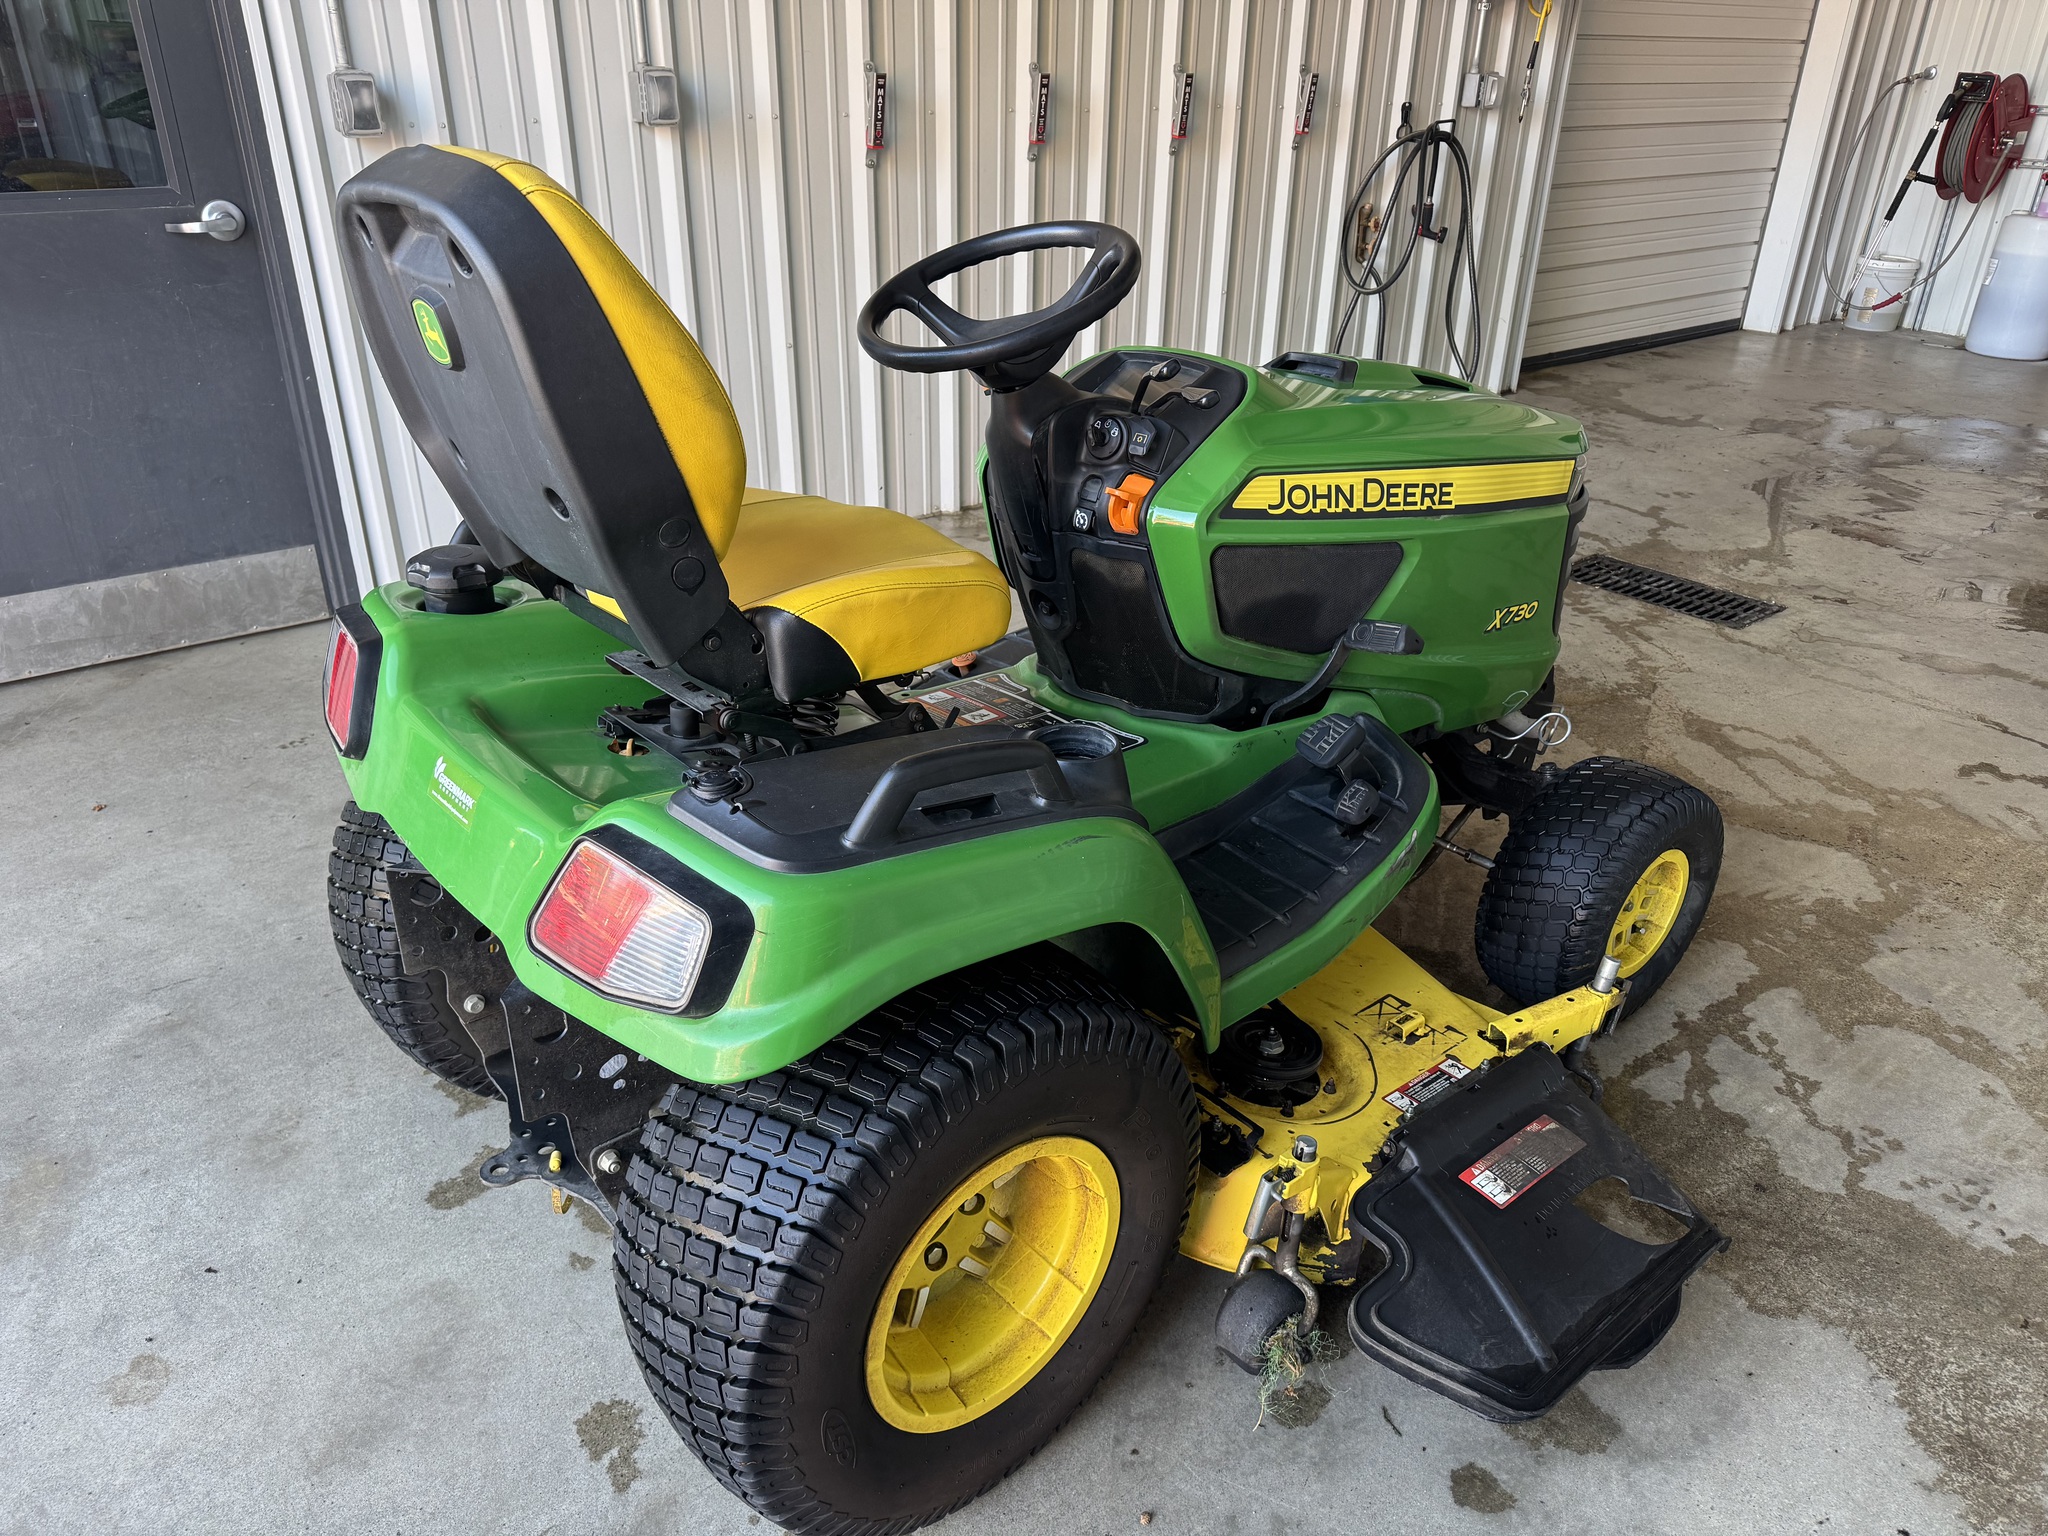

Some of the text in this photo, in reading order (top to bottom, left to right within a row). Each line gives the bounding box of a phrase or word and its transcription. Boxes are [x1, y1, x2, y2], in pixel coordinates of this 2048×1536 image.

[1040, 86, 1048, 116] MATS
[1183, 85, 1191, 113] MATS
[1308, 85, 1316, 110] MATS
[1267, 477, 1455, 512] JOHN DEERE
[1485, 600, 1539, 634] X730
[438, 772, 477, 809] GREENMARK
[1411, 1072, 1431, 1086] DANGER
[827, 1423, 854, 1465] CST
